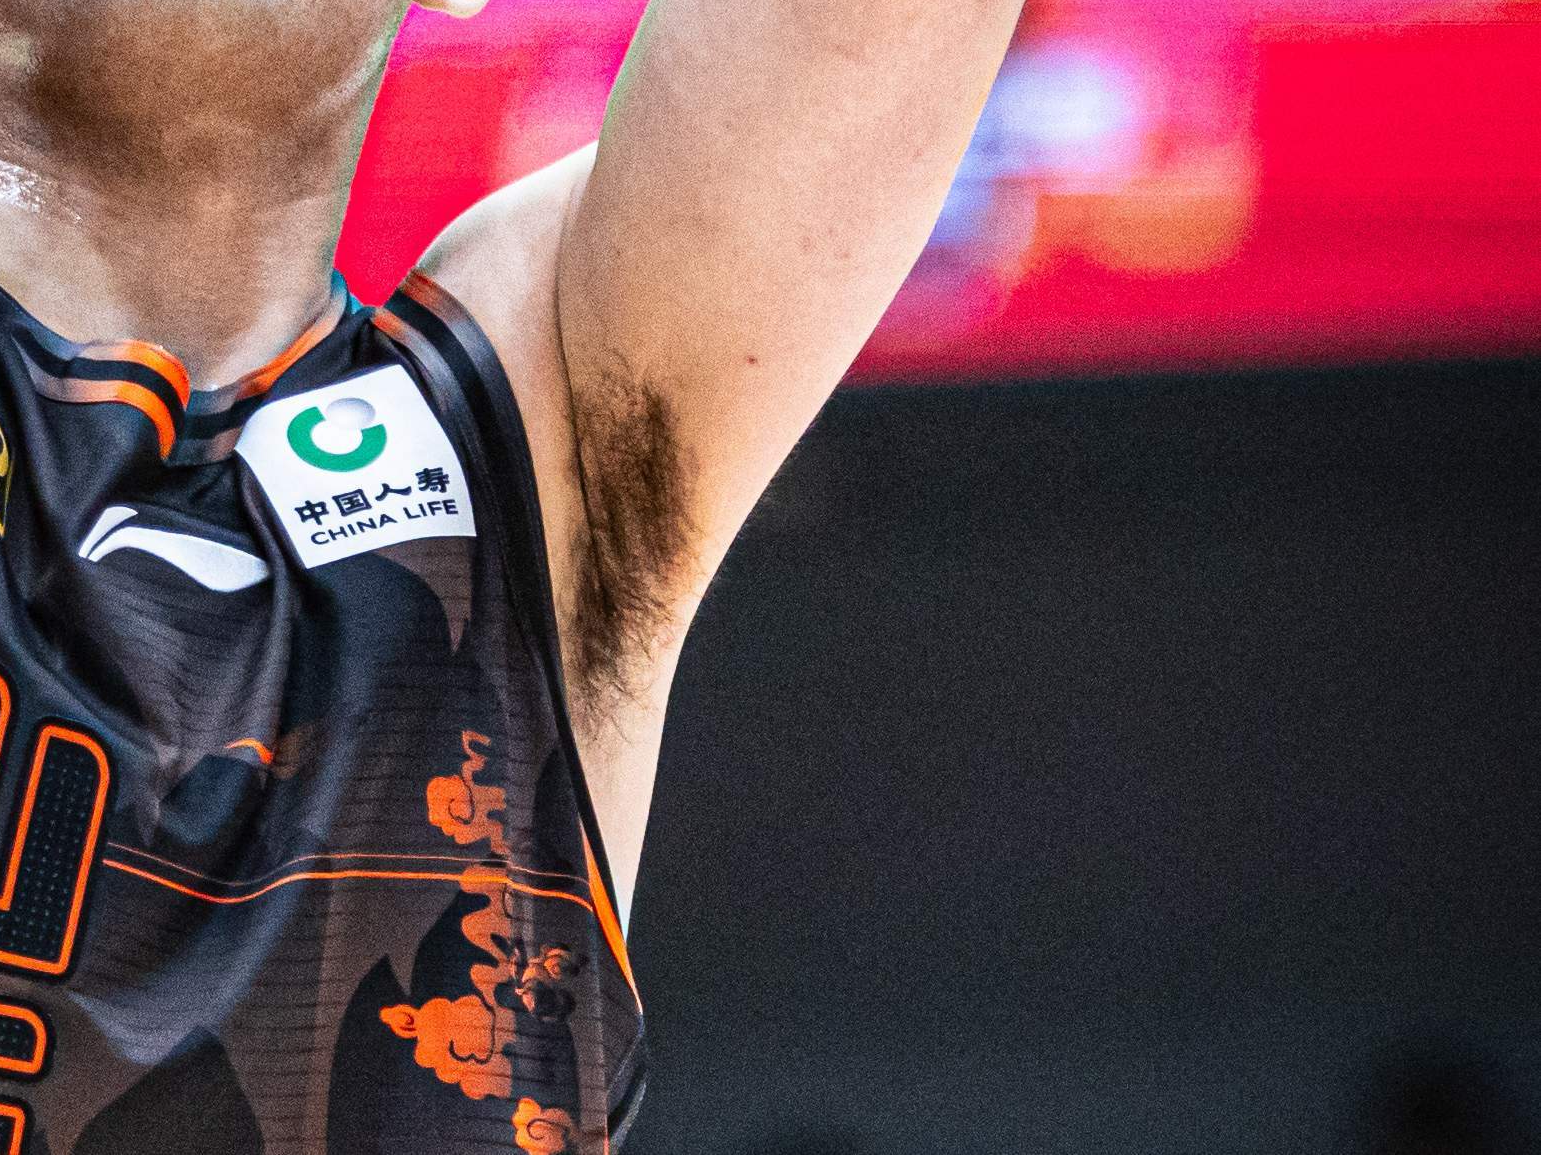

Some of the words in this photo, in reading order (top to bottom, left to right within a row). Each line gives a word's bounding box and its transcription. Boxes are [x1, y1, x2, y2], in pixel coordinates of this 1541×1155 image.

[294, 467, 450, 526] 中国人寿
[310, 513, 398, 545] CHINA
[402, 499, 459, 520] LIFE
